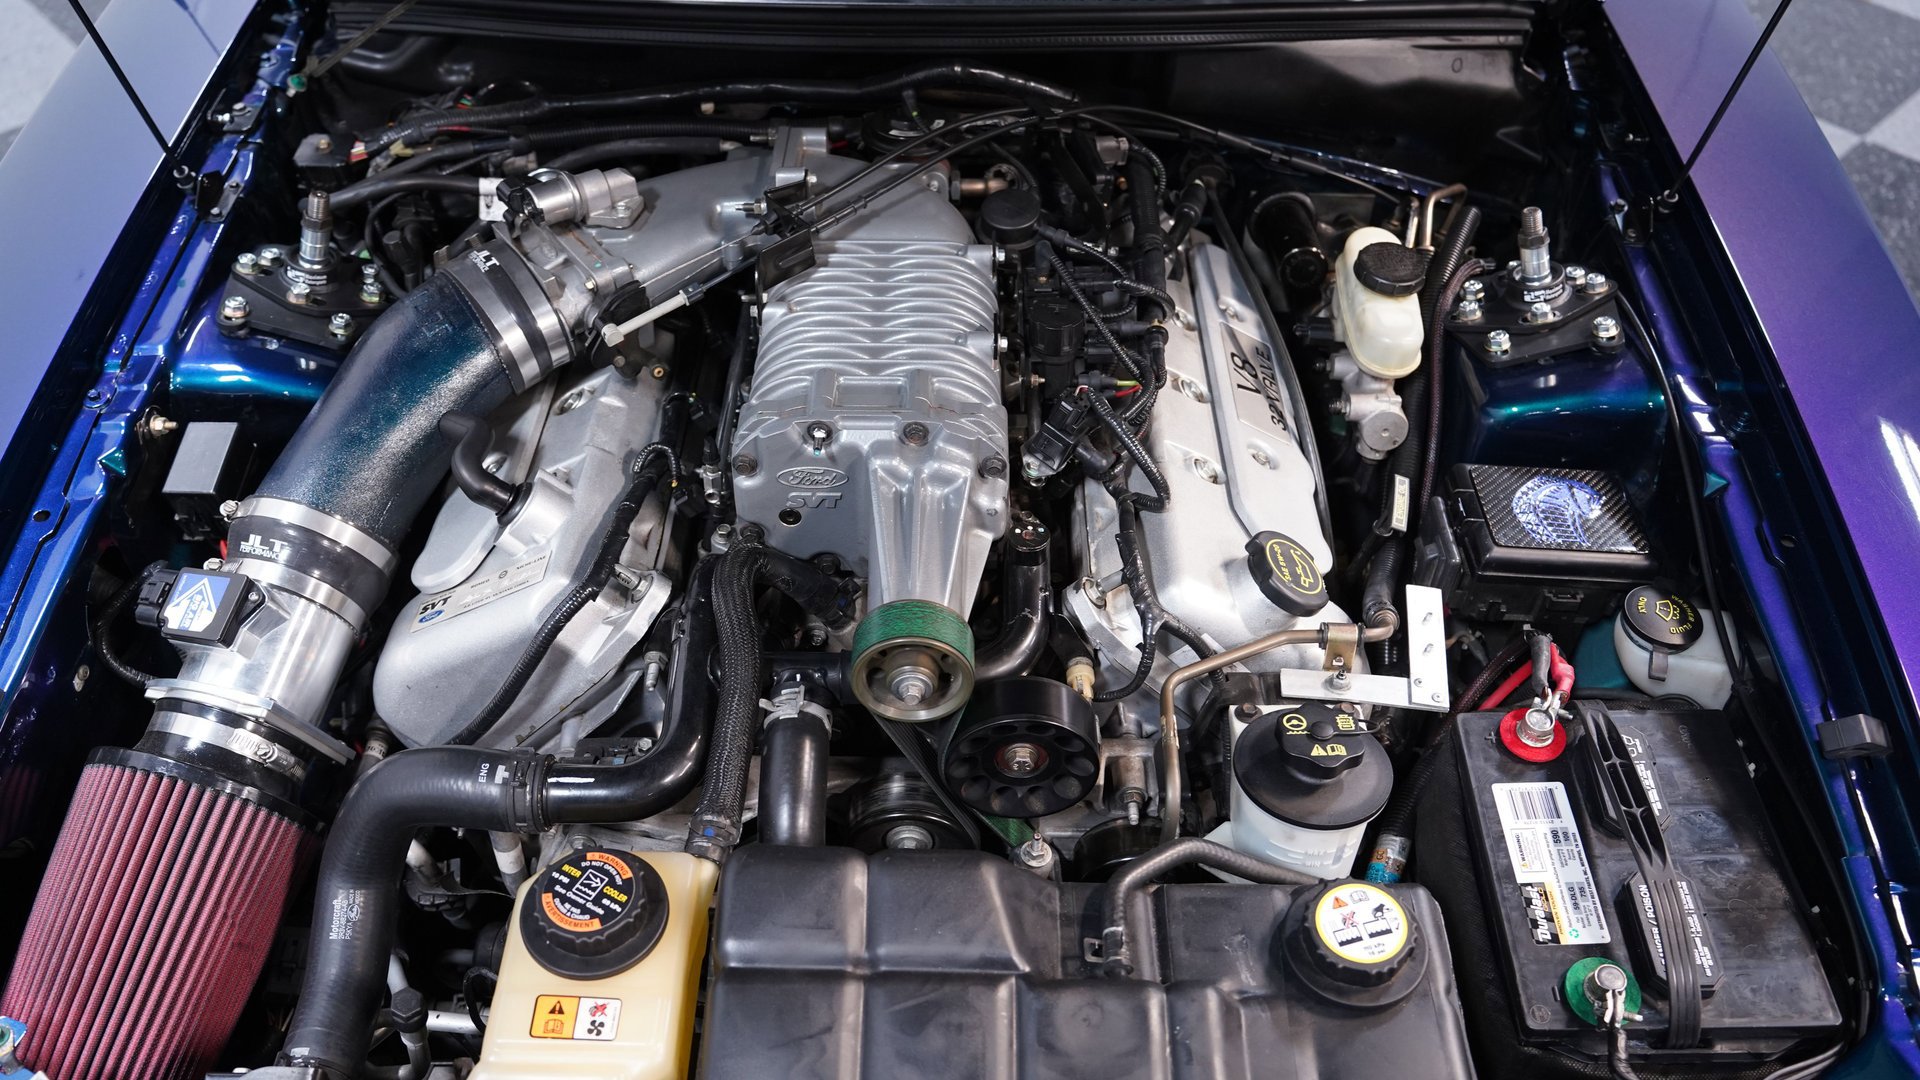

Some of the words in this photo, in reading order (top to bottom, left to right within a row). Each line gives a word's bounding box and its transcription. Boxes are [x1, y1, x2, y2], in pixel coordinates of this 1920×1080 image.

[473, 250, 500, 266] JLT
[1230, 352, 1262, 395] V8
[788, 469, 837, 486] Ford
[786, 491, 842, 509] SVT
[240, 533, 288, 553] JLT
[419, 596, 452, 615] SVT
[1637, 596, 1647, 613] ONLY
[1670, 622, 1692, 635] FLUID
[478, 763, 490, 783] ENG
[1551, 829, 1561, 843] 590
[1561, 831, 1570, 842] 100
[562, 864, 582, 878] INTER
[598, 853, 629, 876] WARNING
[603, 864, 620, 876] OPEN
[552, 871, 559, 879] 10
[554, 885, 567, 894] See
[566, 891, 586, 905] Owner
[586, 902, 605, 915] Guide
[603, 885, 628, 902] COOLER
[1568, 887, 1580, 910] 59-DLG
[1577, 886, 1587, 897] 735
[1639, 884, 1656, 918] POISON
[329, 899, 342, 940] Motorcraft
[545, 901, 595, 929] AVERTISSEMENT
[1525, 885, 1552, 942] Duralast
